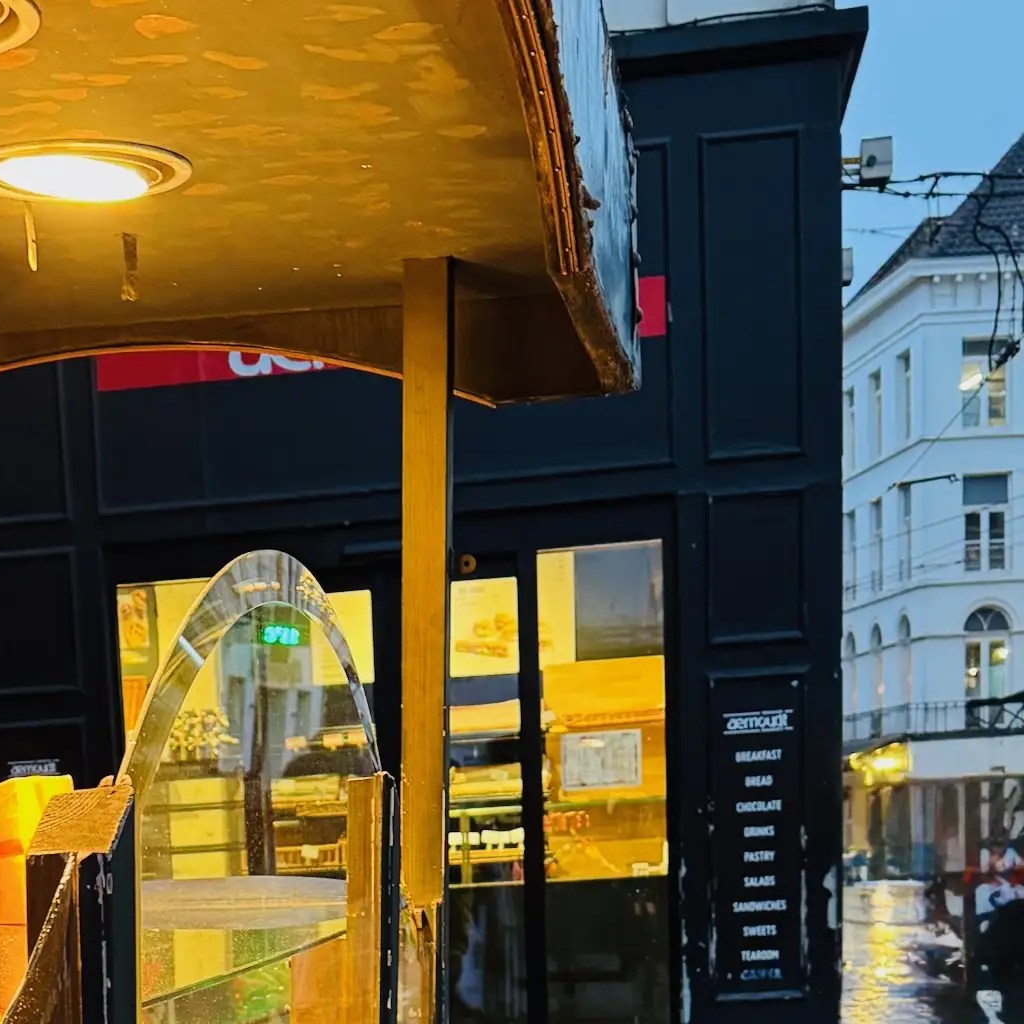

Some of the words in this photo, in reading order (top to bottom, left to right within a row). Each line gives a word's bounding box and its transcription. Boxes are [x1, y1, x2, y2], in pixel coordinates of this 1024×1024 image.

[735, 749, 782, 763] BREAKFAST
[745, 775, 774, 788] BREAD
[736, 800, 782, 813] CHOCOLATE
[743, 825, 775, 838] DRINKS
[743, 850, 775, 862] PASTRY
[743, 875, 776, 888] SALADS
[732, 899, 787, 912] SANDWICHES
[742, 924, 777, 937] SWEETS
[740, 949, 779, 961] TEAROOM
